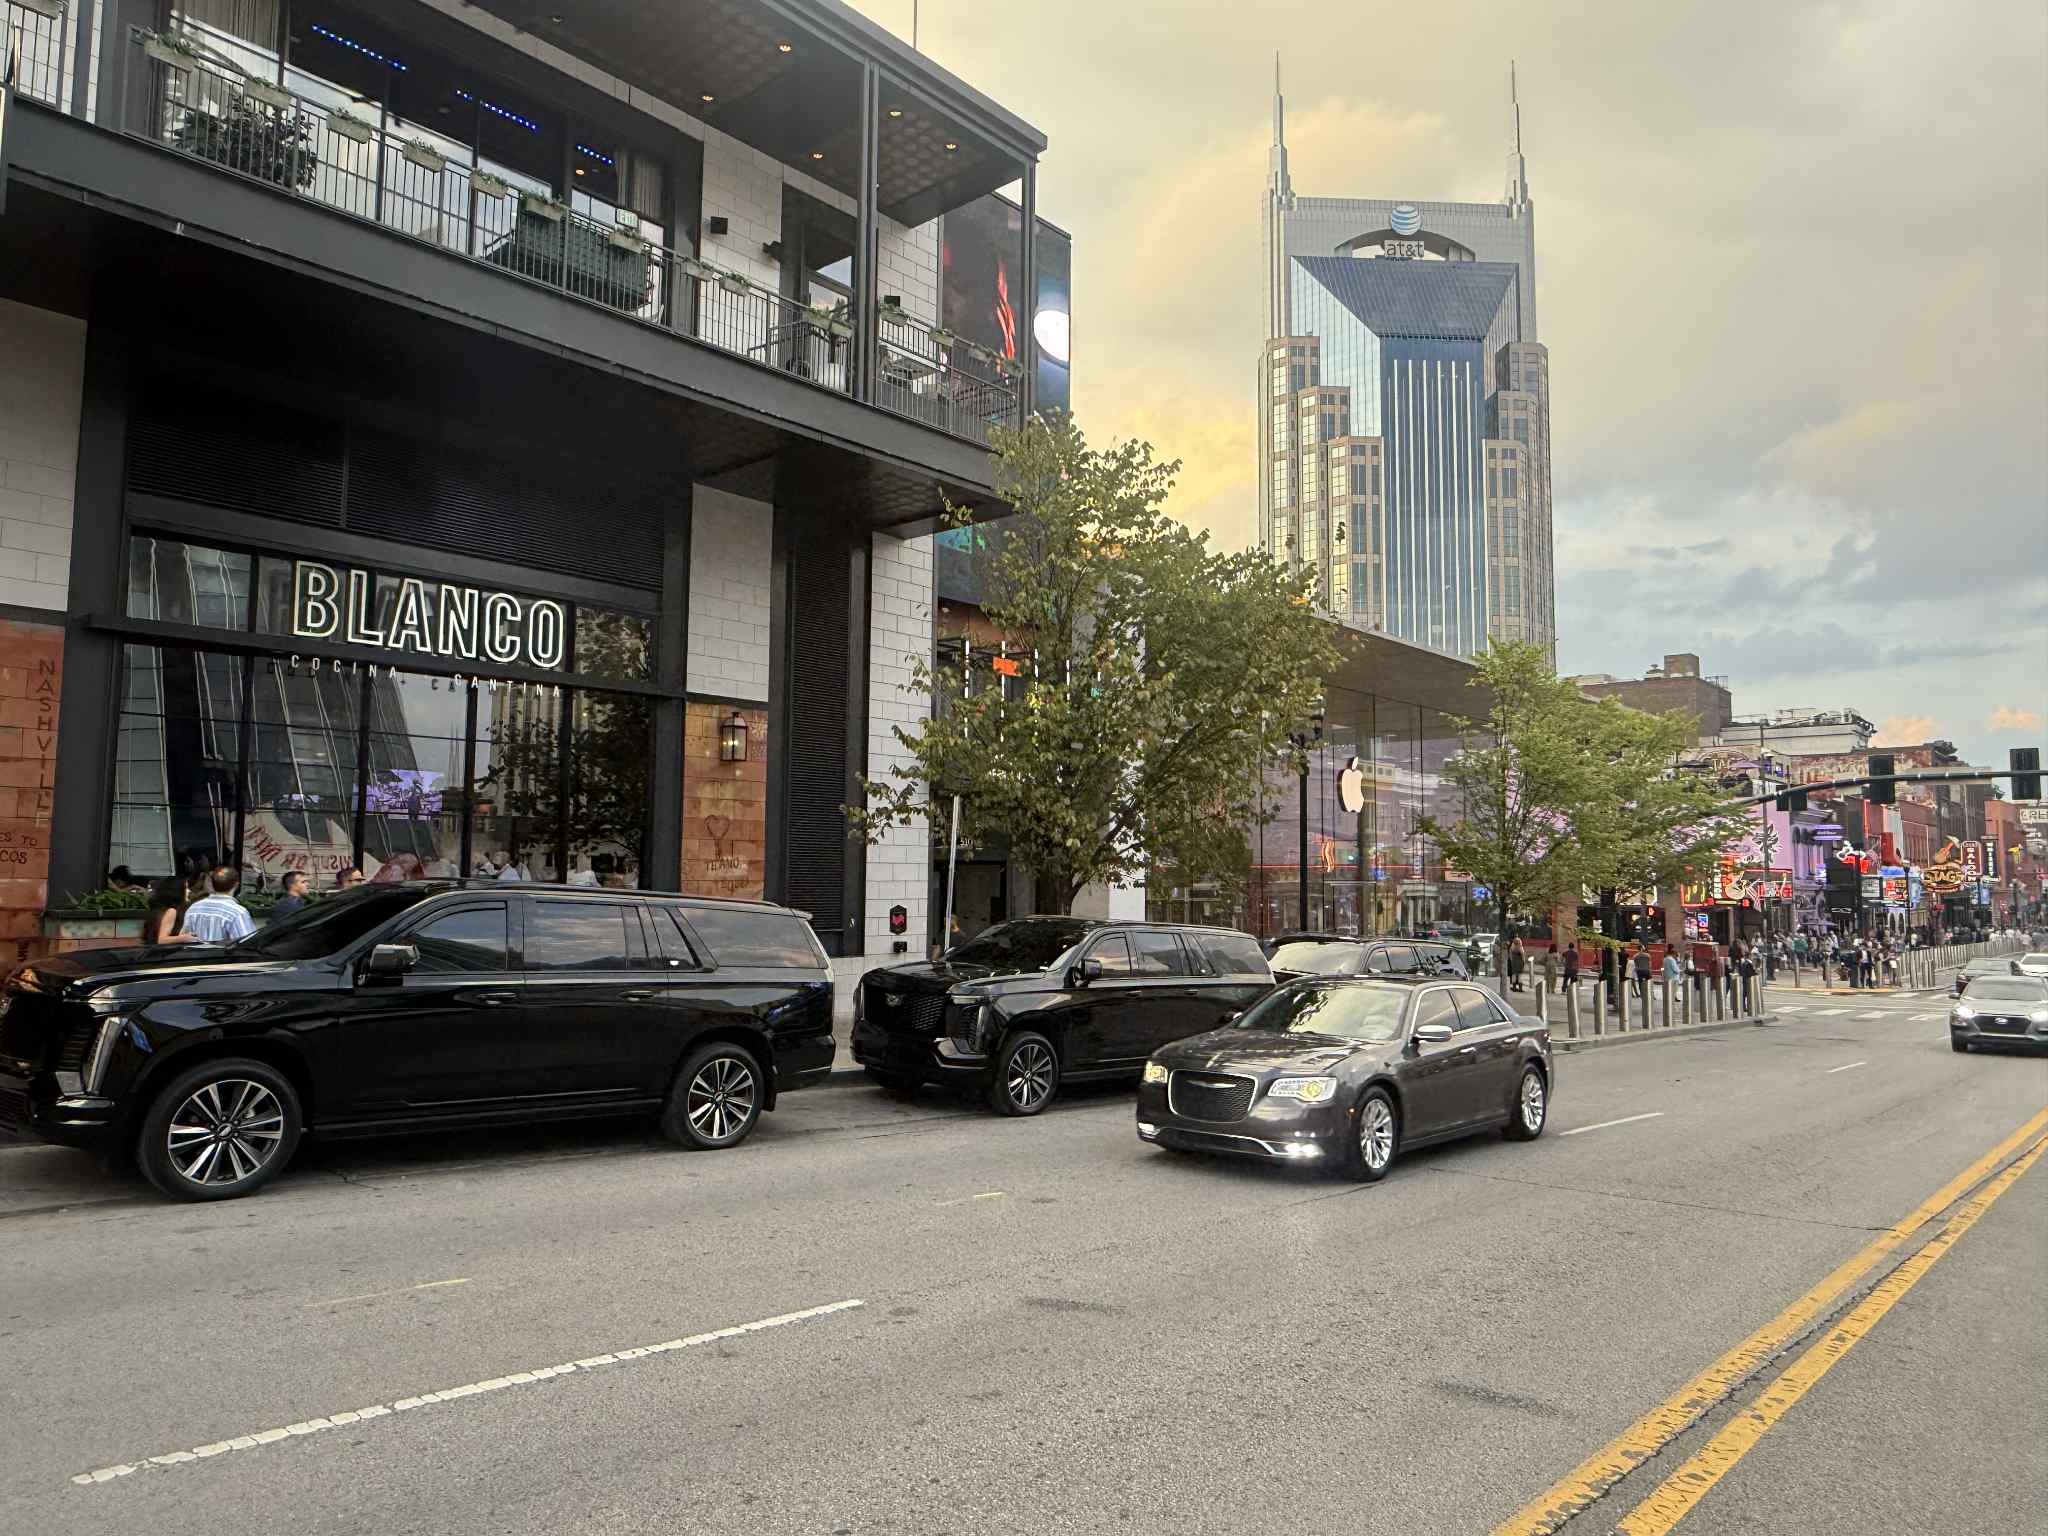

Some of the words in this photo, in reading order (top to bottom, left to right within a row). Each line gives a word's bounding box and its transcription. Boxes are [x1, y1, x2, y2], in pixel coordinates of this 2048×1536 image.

[1386, 240, 1425, 258] at&t
[293, 560, 564, 668] BLANCO
[291, 654, 397, 679] COCINA
[454, 673, 561, 698] CANTINA
[35, 659, 56, 828] NASHVILLE
[1966, 848, 1977, 882] SALOON
